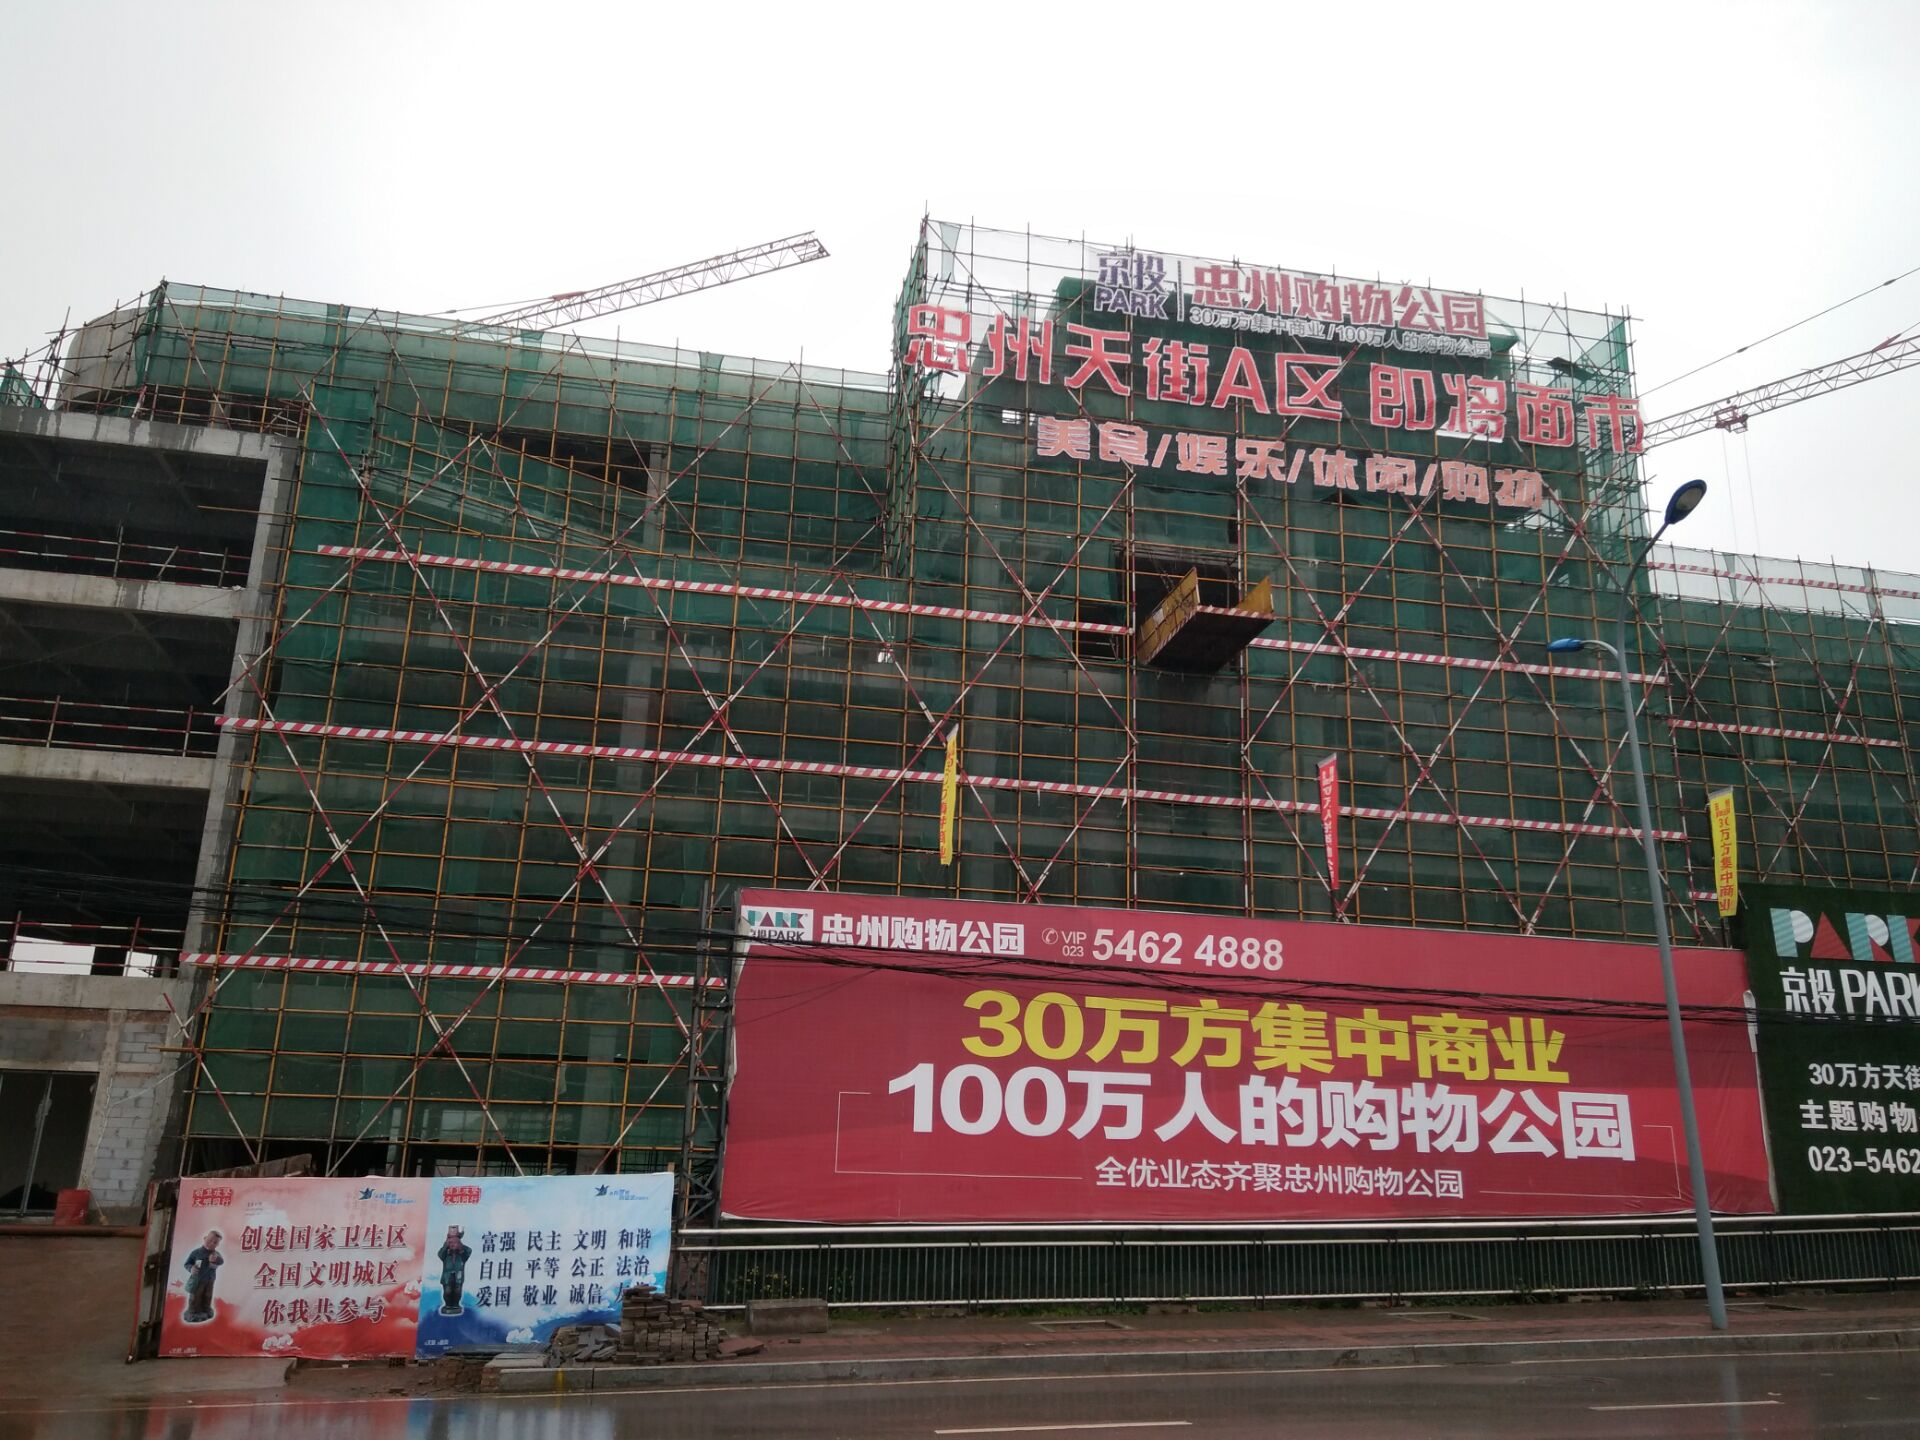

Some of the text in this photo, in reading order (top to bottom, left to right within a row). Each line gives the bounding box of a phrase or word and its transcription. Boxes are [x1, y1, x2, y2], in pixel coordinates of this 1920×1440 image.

[1094, 285, 1169, 321] PARK
[1192, 265, 1489, 339] 忠州购物公园
[821, 913, 1025, 955] 忠州购物公园
[1062, 931, 1087, 942] VIP
[1092, 928, 1283, 971] 5462 4888
[1062, 945, 1084, 957] 023
[1779, 966, 1841, 1019] 京投
[961, 990, 1571, 1084] 30万方集中商业
[888, 1062, 1637, 1161] 100万人的购物公园
[1095, 1156, 1464, 1199] 全优业态齐聚忠州购物公园
[241, 1224, 408, 1251] 创建国家卫生区
[482, 1228, 652, 1253] 富强 民主 文明 和谐
[254, 1260, 399, 1288] 全国文明城区
[480, 1255, 650, 1280] 自由 平等 公正 法治
[263, 1296, 385, 1325] 你我共参与
[476, 1285, 511, 1307] 爱国
[523, 1285, 558, 1306] 敬业
[569, 1283, 603, 1305] 诚信
